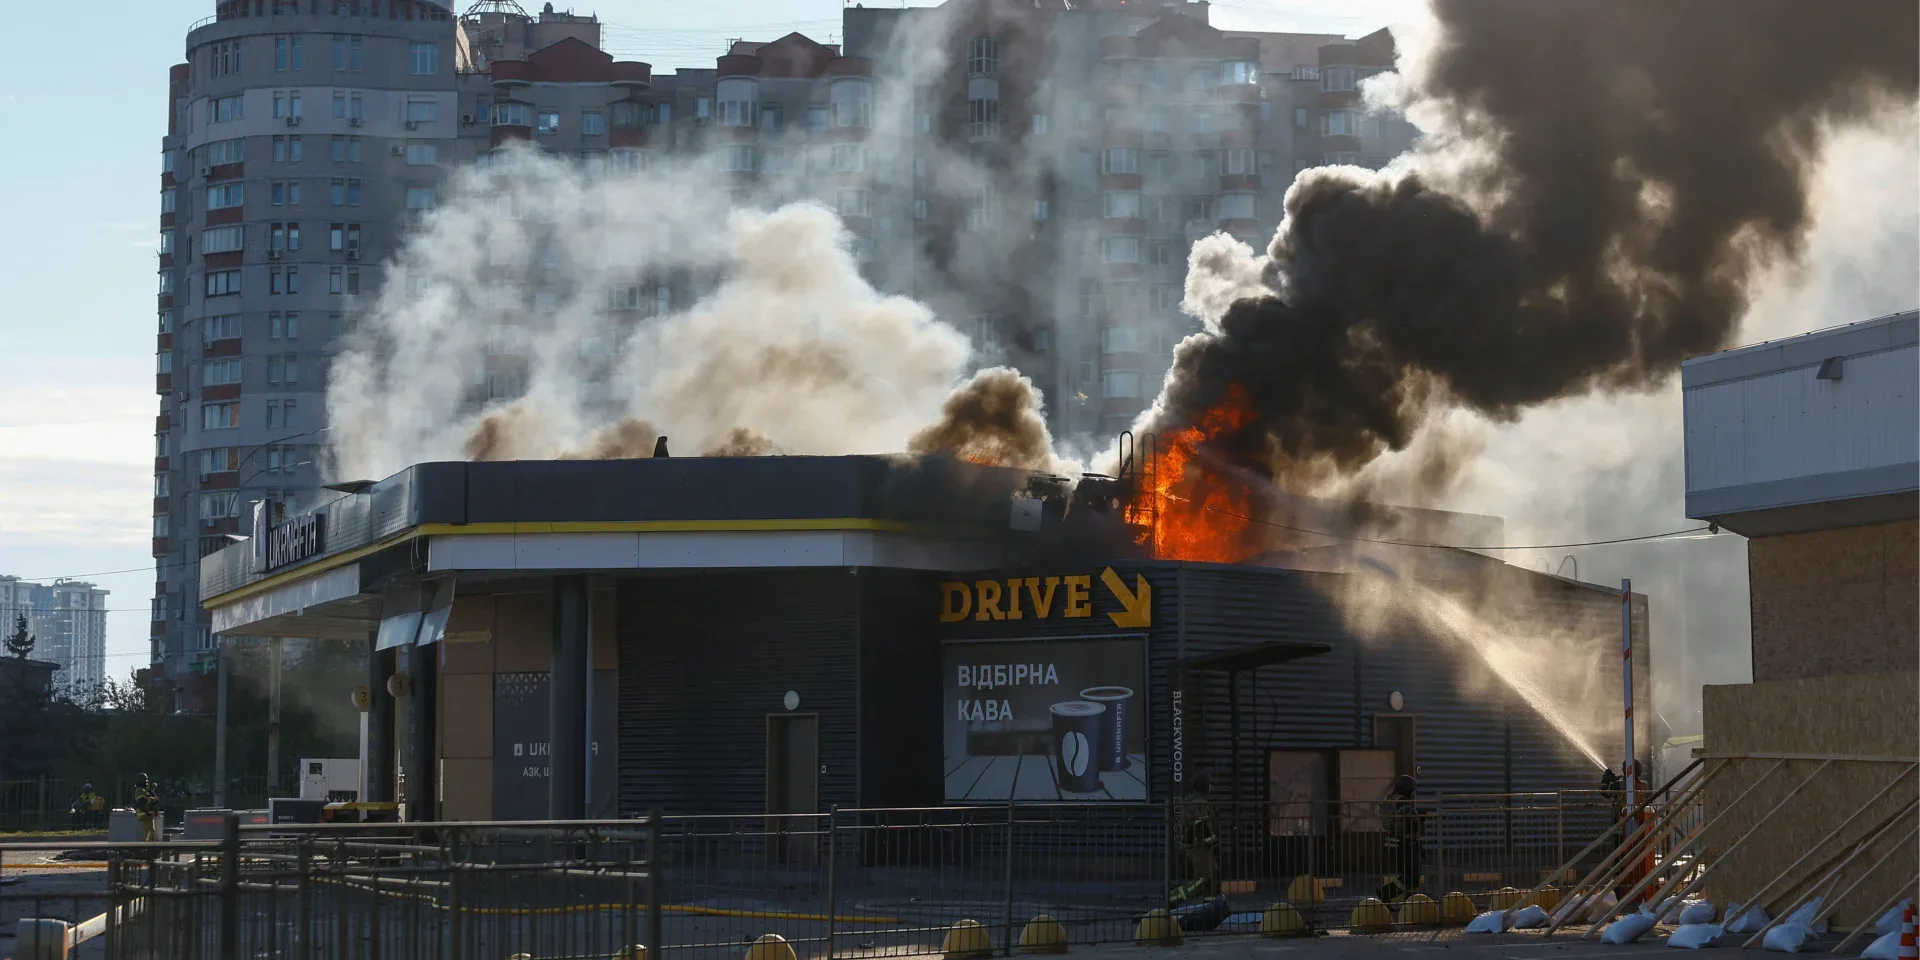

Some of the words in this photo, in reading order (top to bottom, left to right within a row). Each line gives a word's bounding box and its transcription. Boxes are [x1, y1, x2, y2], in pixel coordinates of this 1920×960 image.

[268, 514, 317, 570] UKRNAFTA
[940, 574, 1092, 623] DRIVE
[958, 663, 1059, 690] ВІДБІРНА
[958, 699, 1014, 721] КАВА
[1173, 690, 1183, 783] BLACKWOOD
